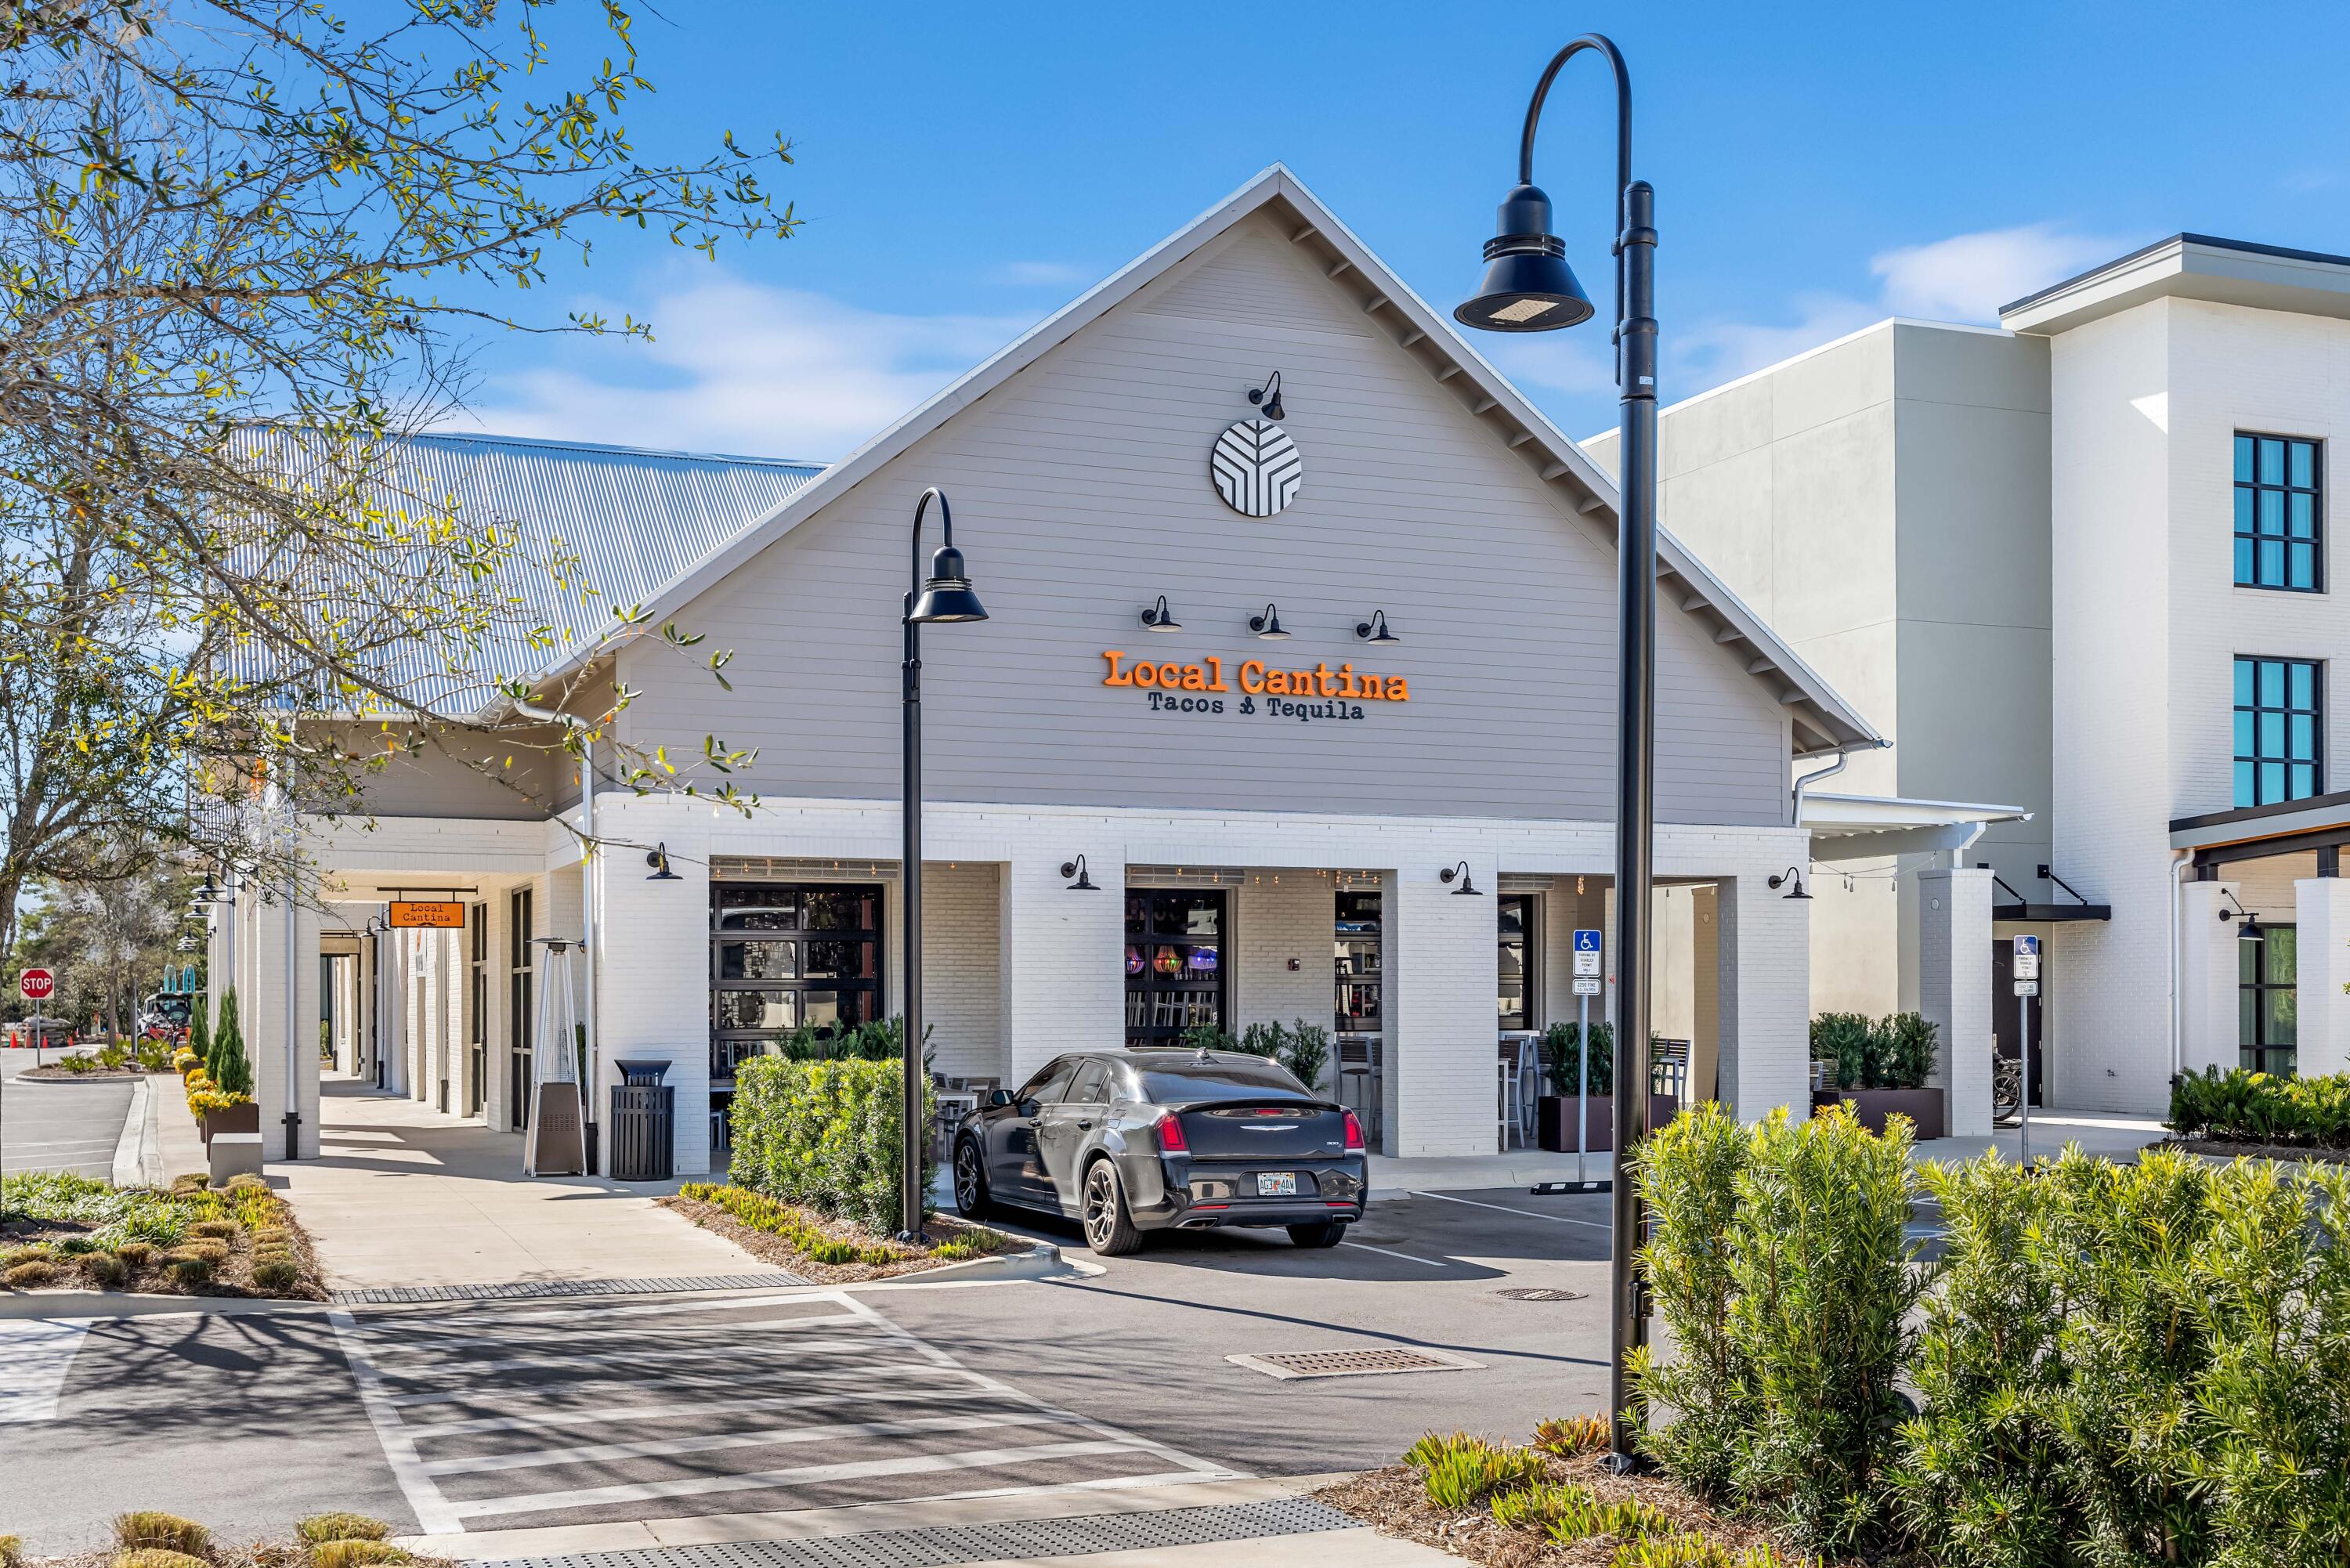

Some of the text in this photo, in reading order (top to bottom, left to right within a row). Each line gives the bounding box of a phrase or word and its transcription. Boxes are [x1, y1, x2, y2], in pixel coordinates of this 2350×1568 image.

[1102, 650, 1410, 702] Local Cantina
[1148, 692, 1365, 722] Tacos & Tequila
[410, 903, 444, 912] Local
[403, 912, 450, 922] Cantina
[23, 977, 52, 990] STOP
